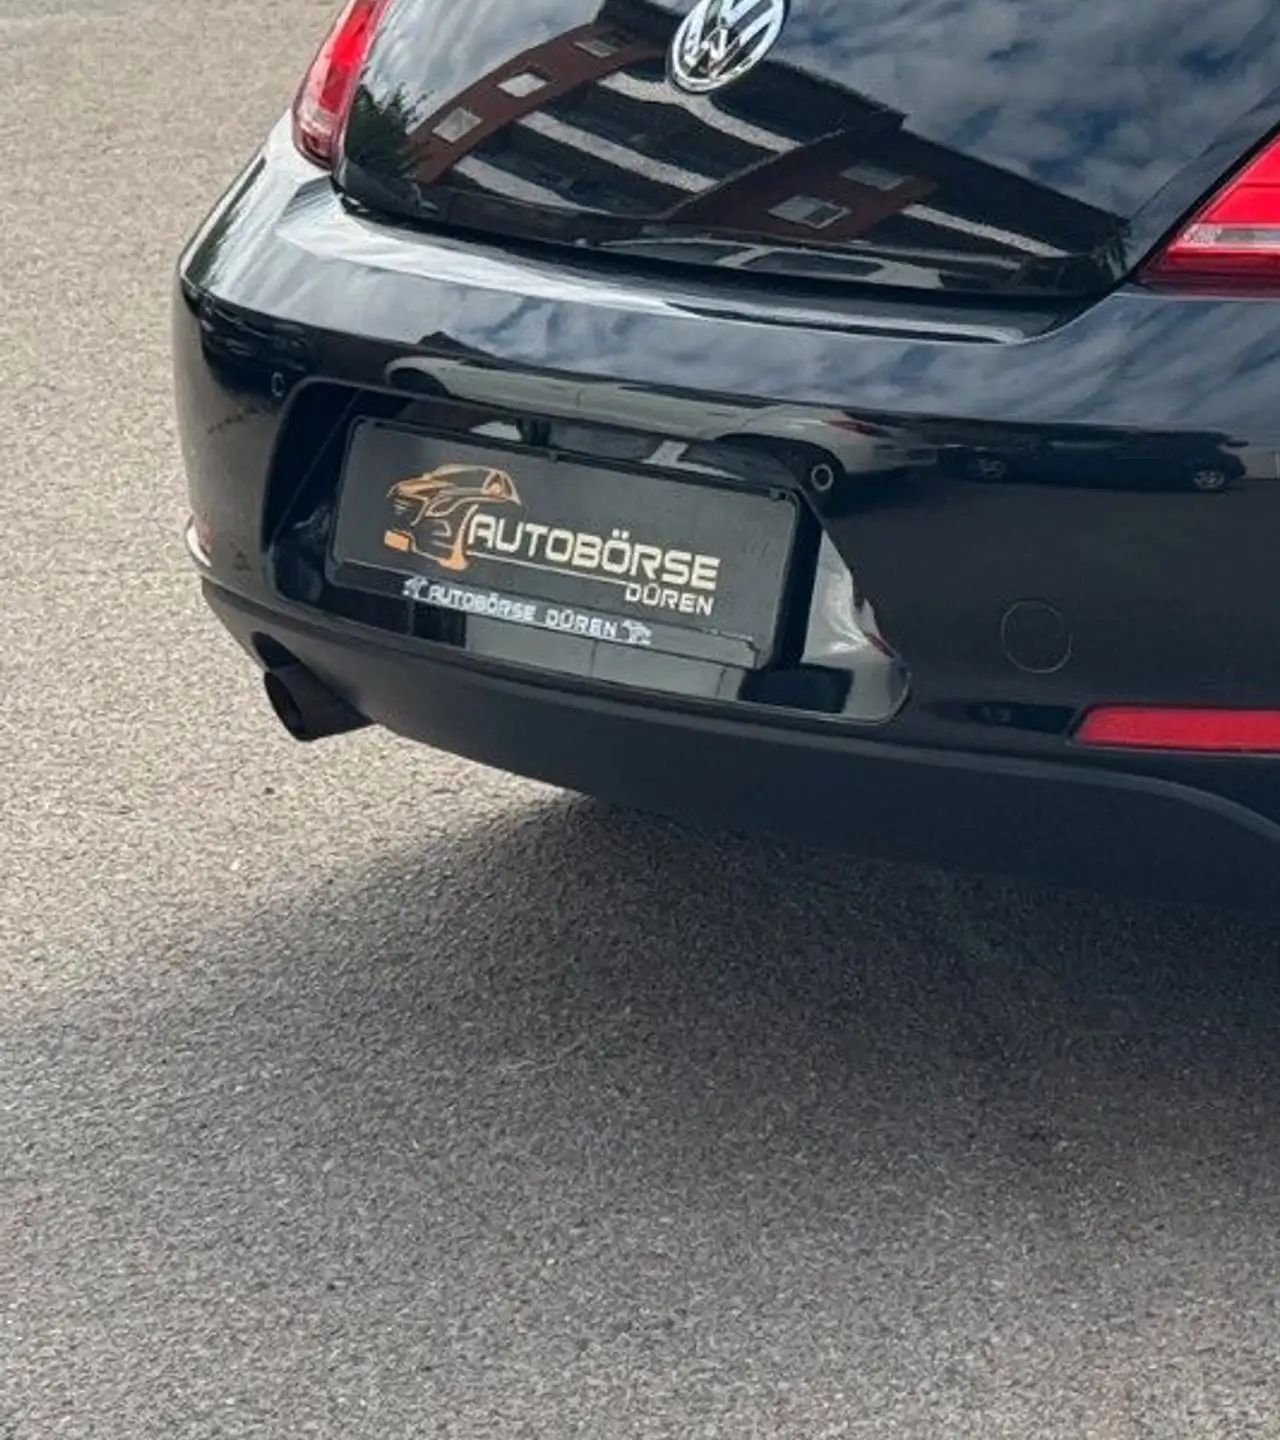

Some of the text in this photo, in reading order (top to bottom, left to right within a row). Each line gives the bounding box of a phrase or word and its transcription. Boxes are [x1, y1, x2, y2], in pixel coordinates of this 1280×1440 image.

[467, 514, 721, 590] AUTOBÖRSE
[428, 586, 617, 639] AUTOBÖRSE DÜREN
[625, 582, 714, 616] DÜREN
